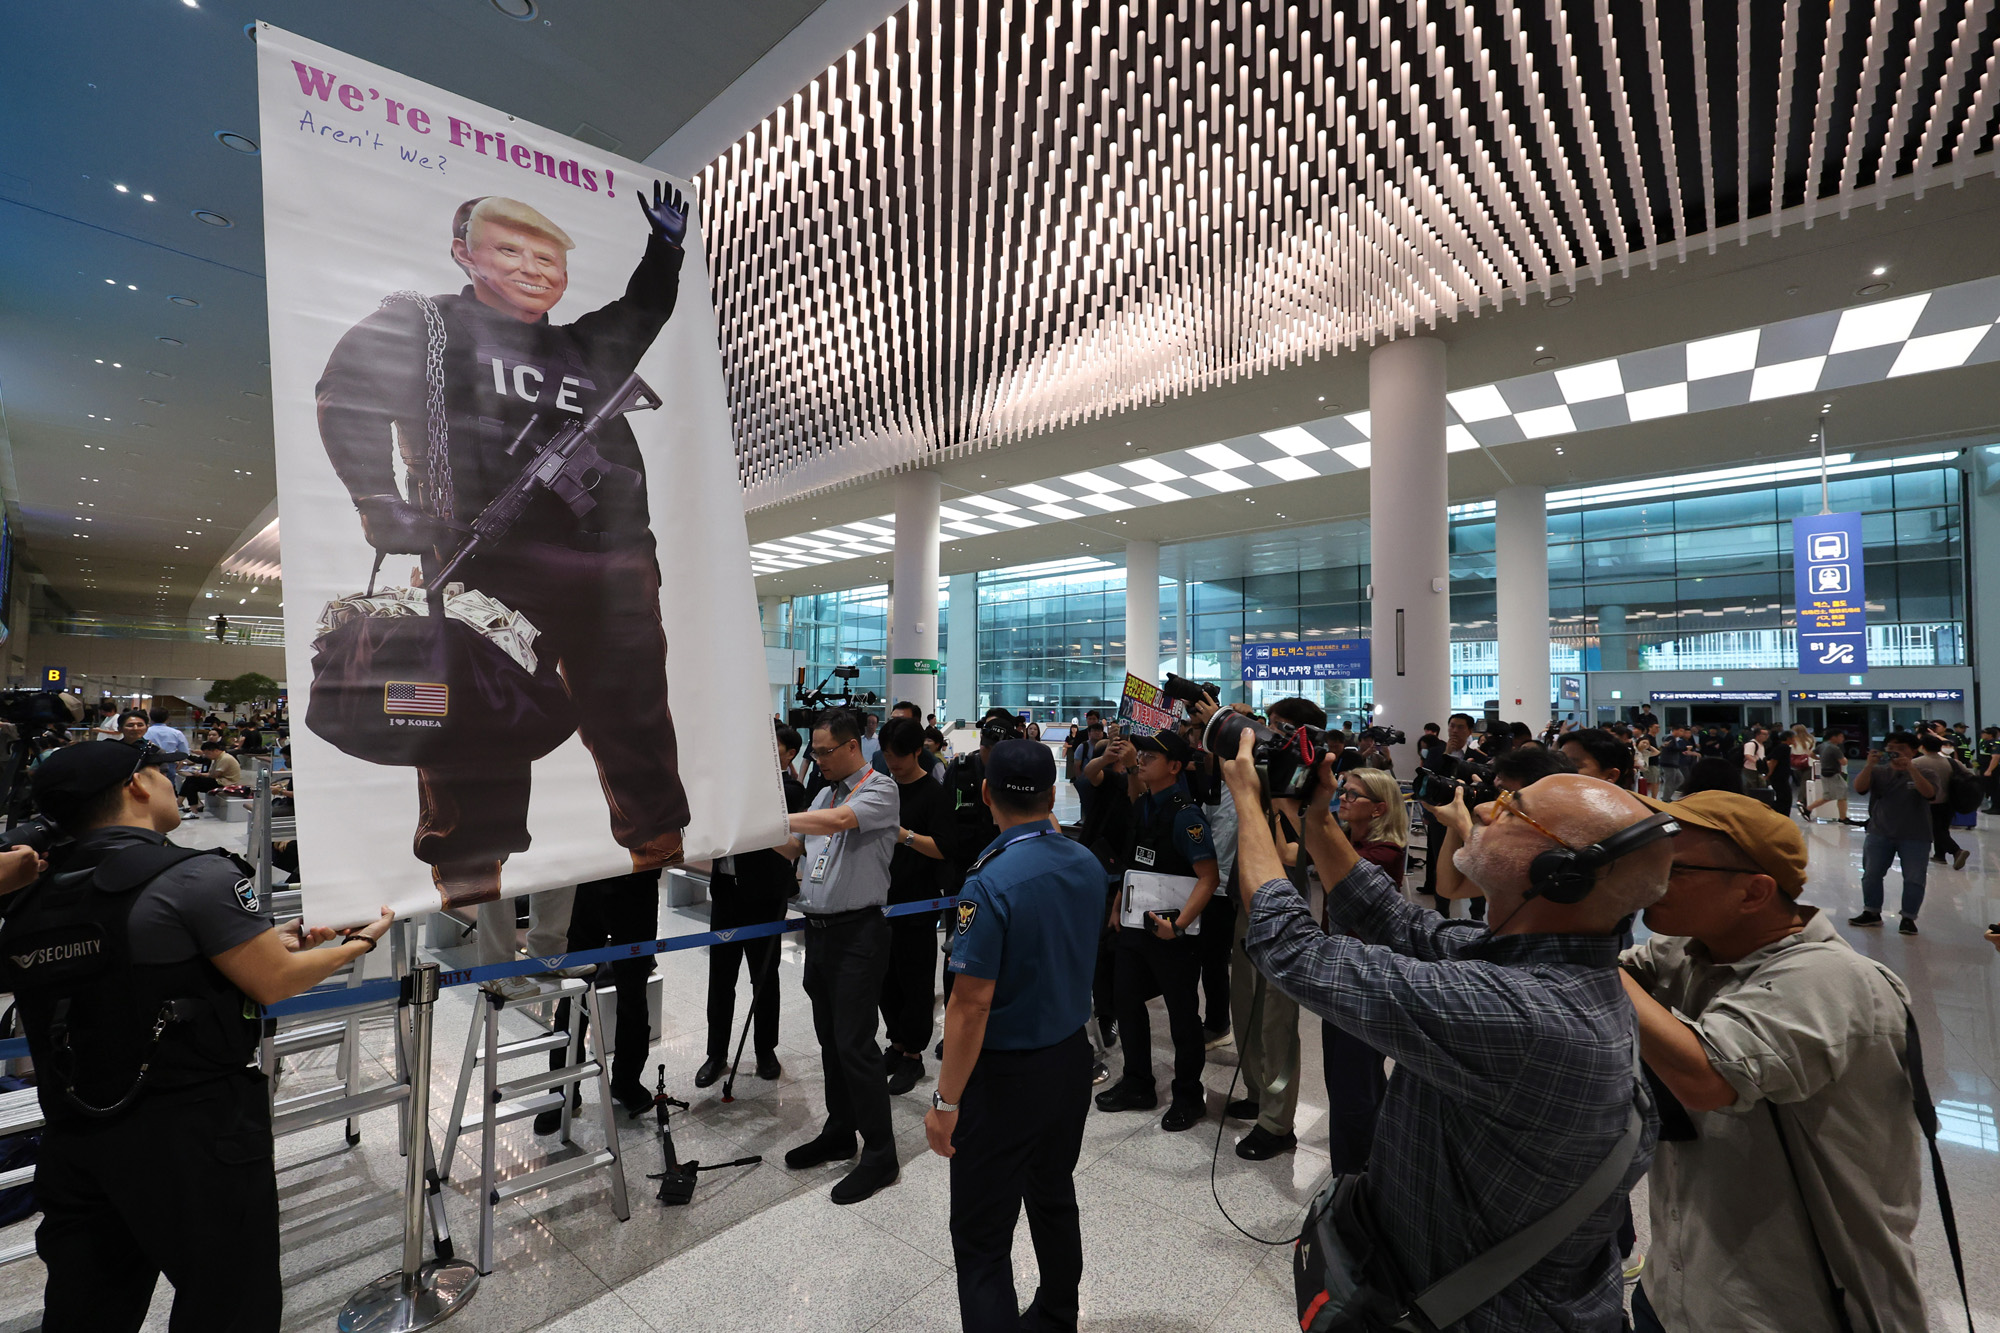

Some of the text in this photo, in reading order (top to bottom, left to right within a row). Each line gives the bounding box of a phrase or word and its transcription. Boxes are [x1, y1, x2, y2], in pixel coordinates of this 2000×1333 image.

[291, 59, 616, 198] We're Friends!
[299, 110, 447, 175] Aren't We?
[491, 357, 584, 414] ICE
[1810, 642, 1824, 651] B1
[48, 670, 60, 681] B
[407, 719, 442, 728] KOREA
[1006, 783, 1035, 791] POLICE
[38, 939, 102, 965] SECURITY
[439, 969, 473, 985] RITY
